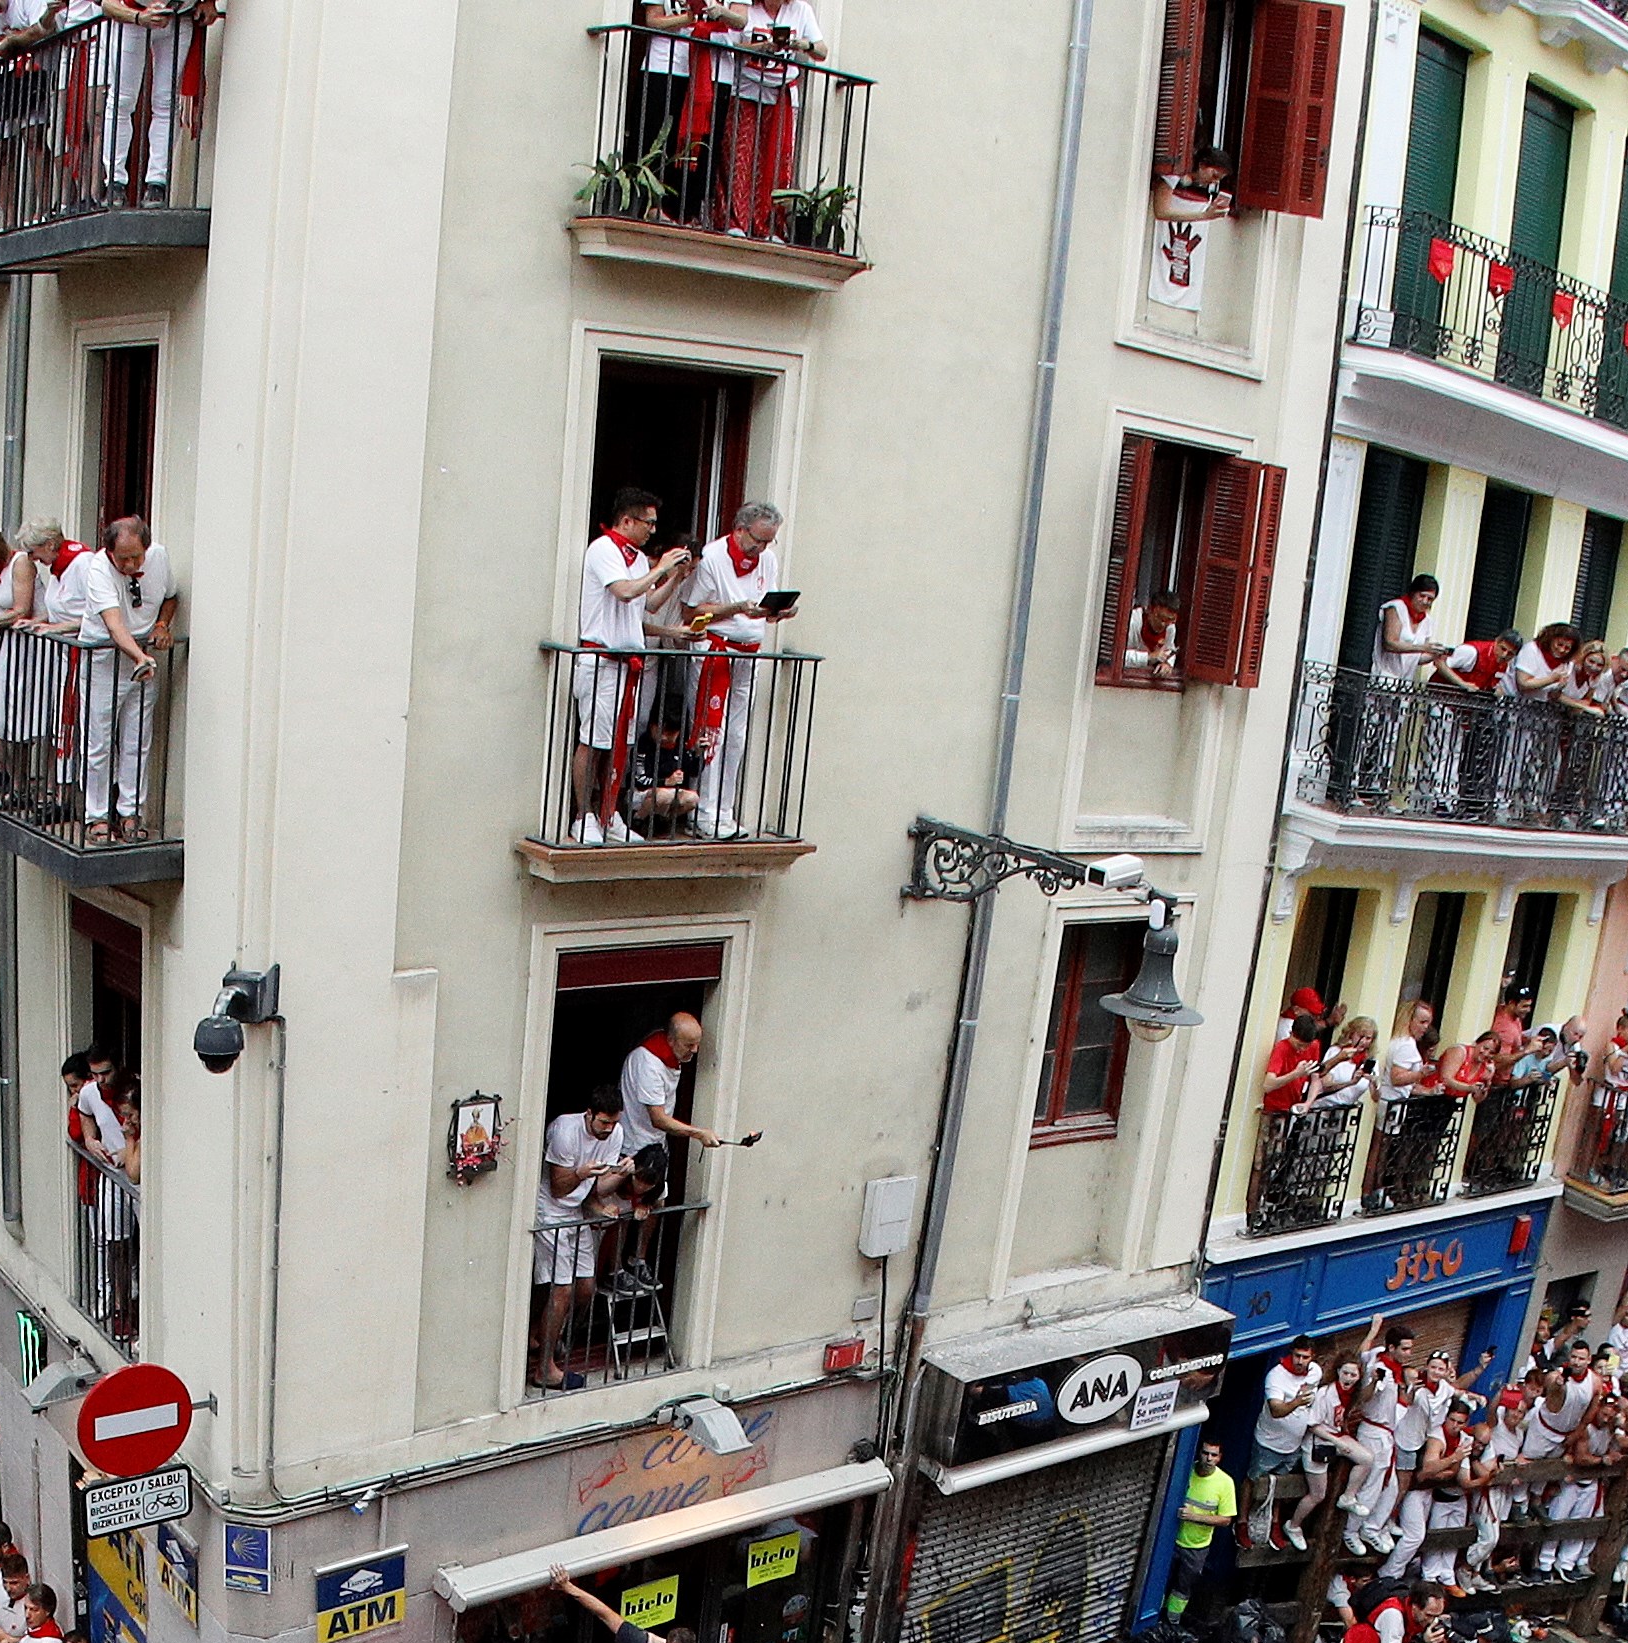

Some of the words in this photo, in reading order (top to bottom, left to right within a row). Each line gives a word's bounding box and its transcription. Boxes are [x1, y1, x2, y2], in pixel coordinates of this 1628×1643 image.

[1149, 1353, 1224, 1381] COMPLEMENTOS
[1070, 1370, 1129, 1412] ANA
[642, 1410, 775, 1470] coe
[91, 1484, 137, 1504] EXCEPTO
[148, 1473, 184, 1490] SALBU:
[90, 1497, 141, 1517] BICICLETAS
[92, 1511, 141, 1531] BIZIKLETAK
[750, 1546, 795, 1570] hielo
[327, 1596, 396, 1639] ATM
[624, 1591, 674, 1617] hielo
